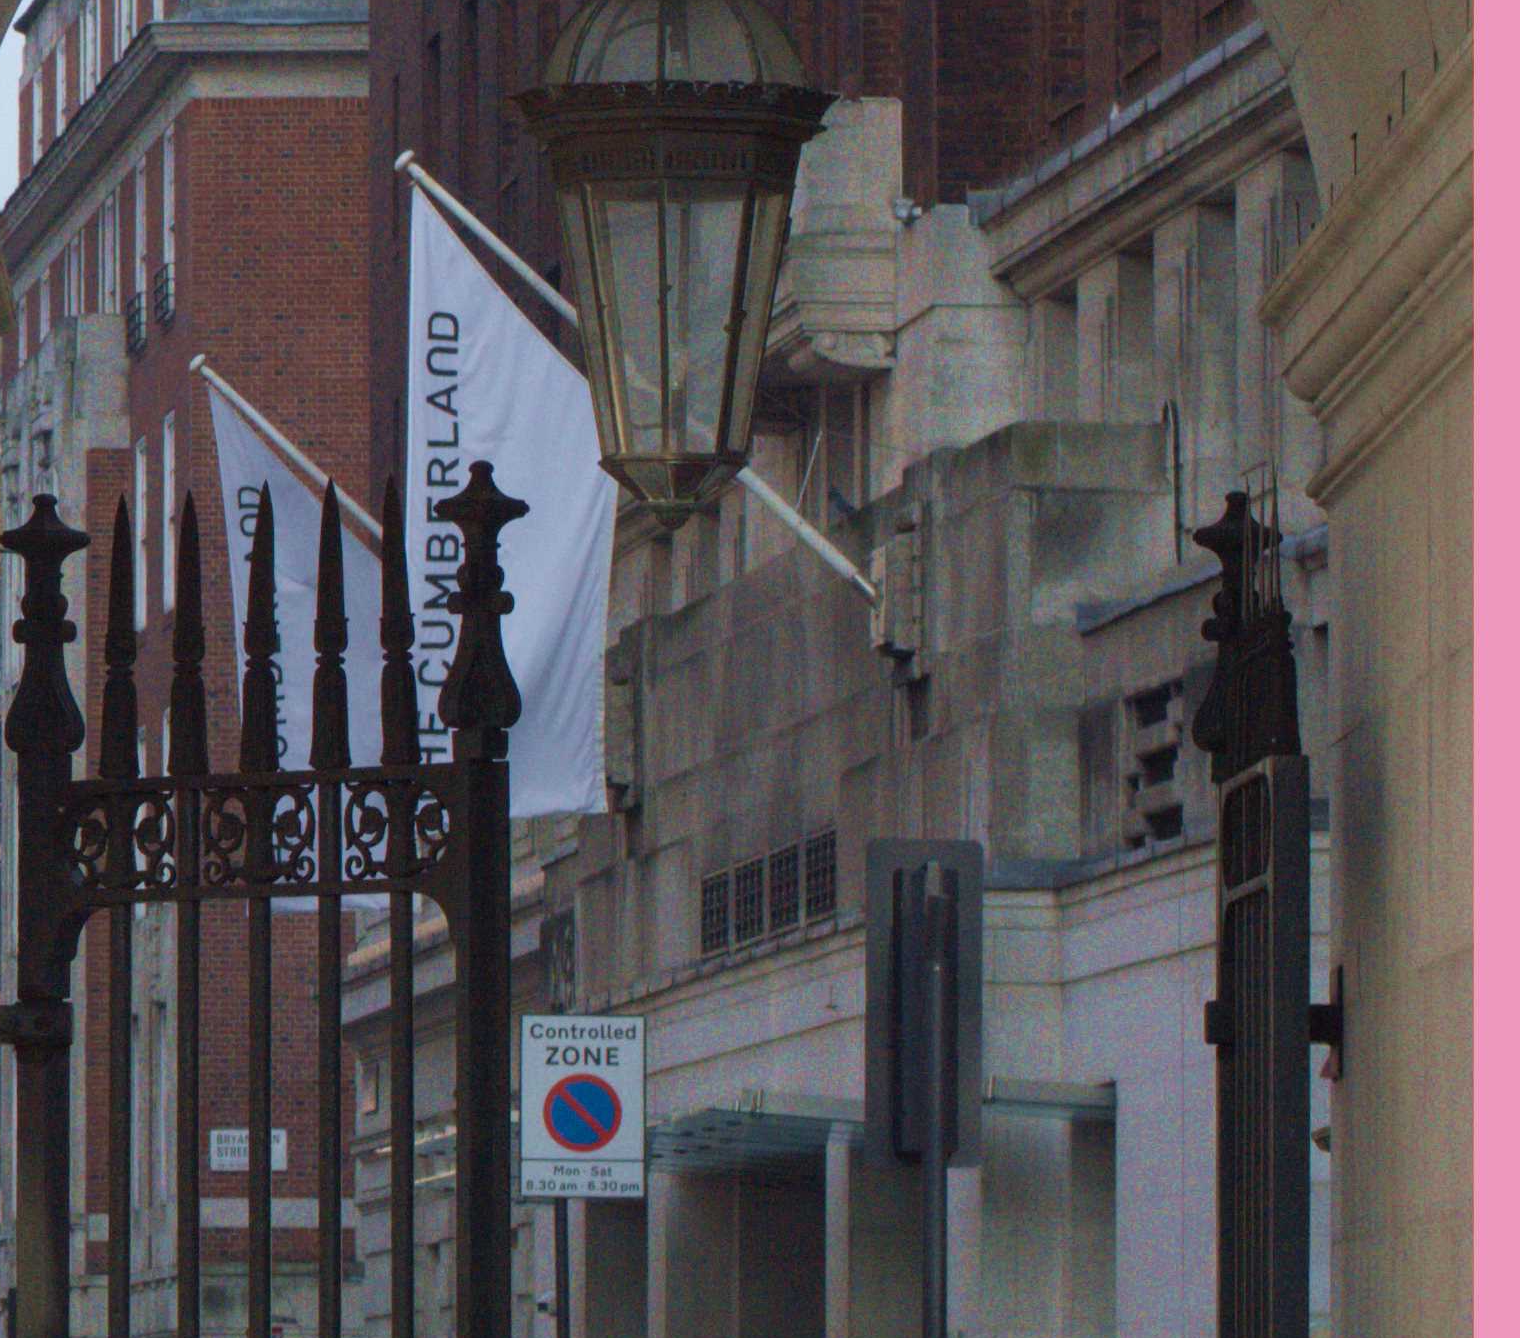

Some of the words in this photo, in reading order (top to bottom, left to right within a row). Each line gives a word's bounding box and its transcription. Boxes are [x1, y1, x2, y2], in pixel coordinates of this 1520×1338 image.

[529, 1023, 637, 1040] Controlled
[545, 1046, 620, 1066] ZONE
[553, 1166, 581, 1177] Mon
[590, 1165, 613, 1177] Sat
